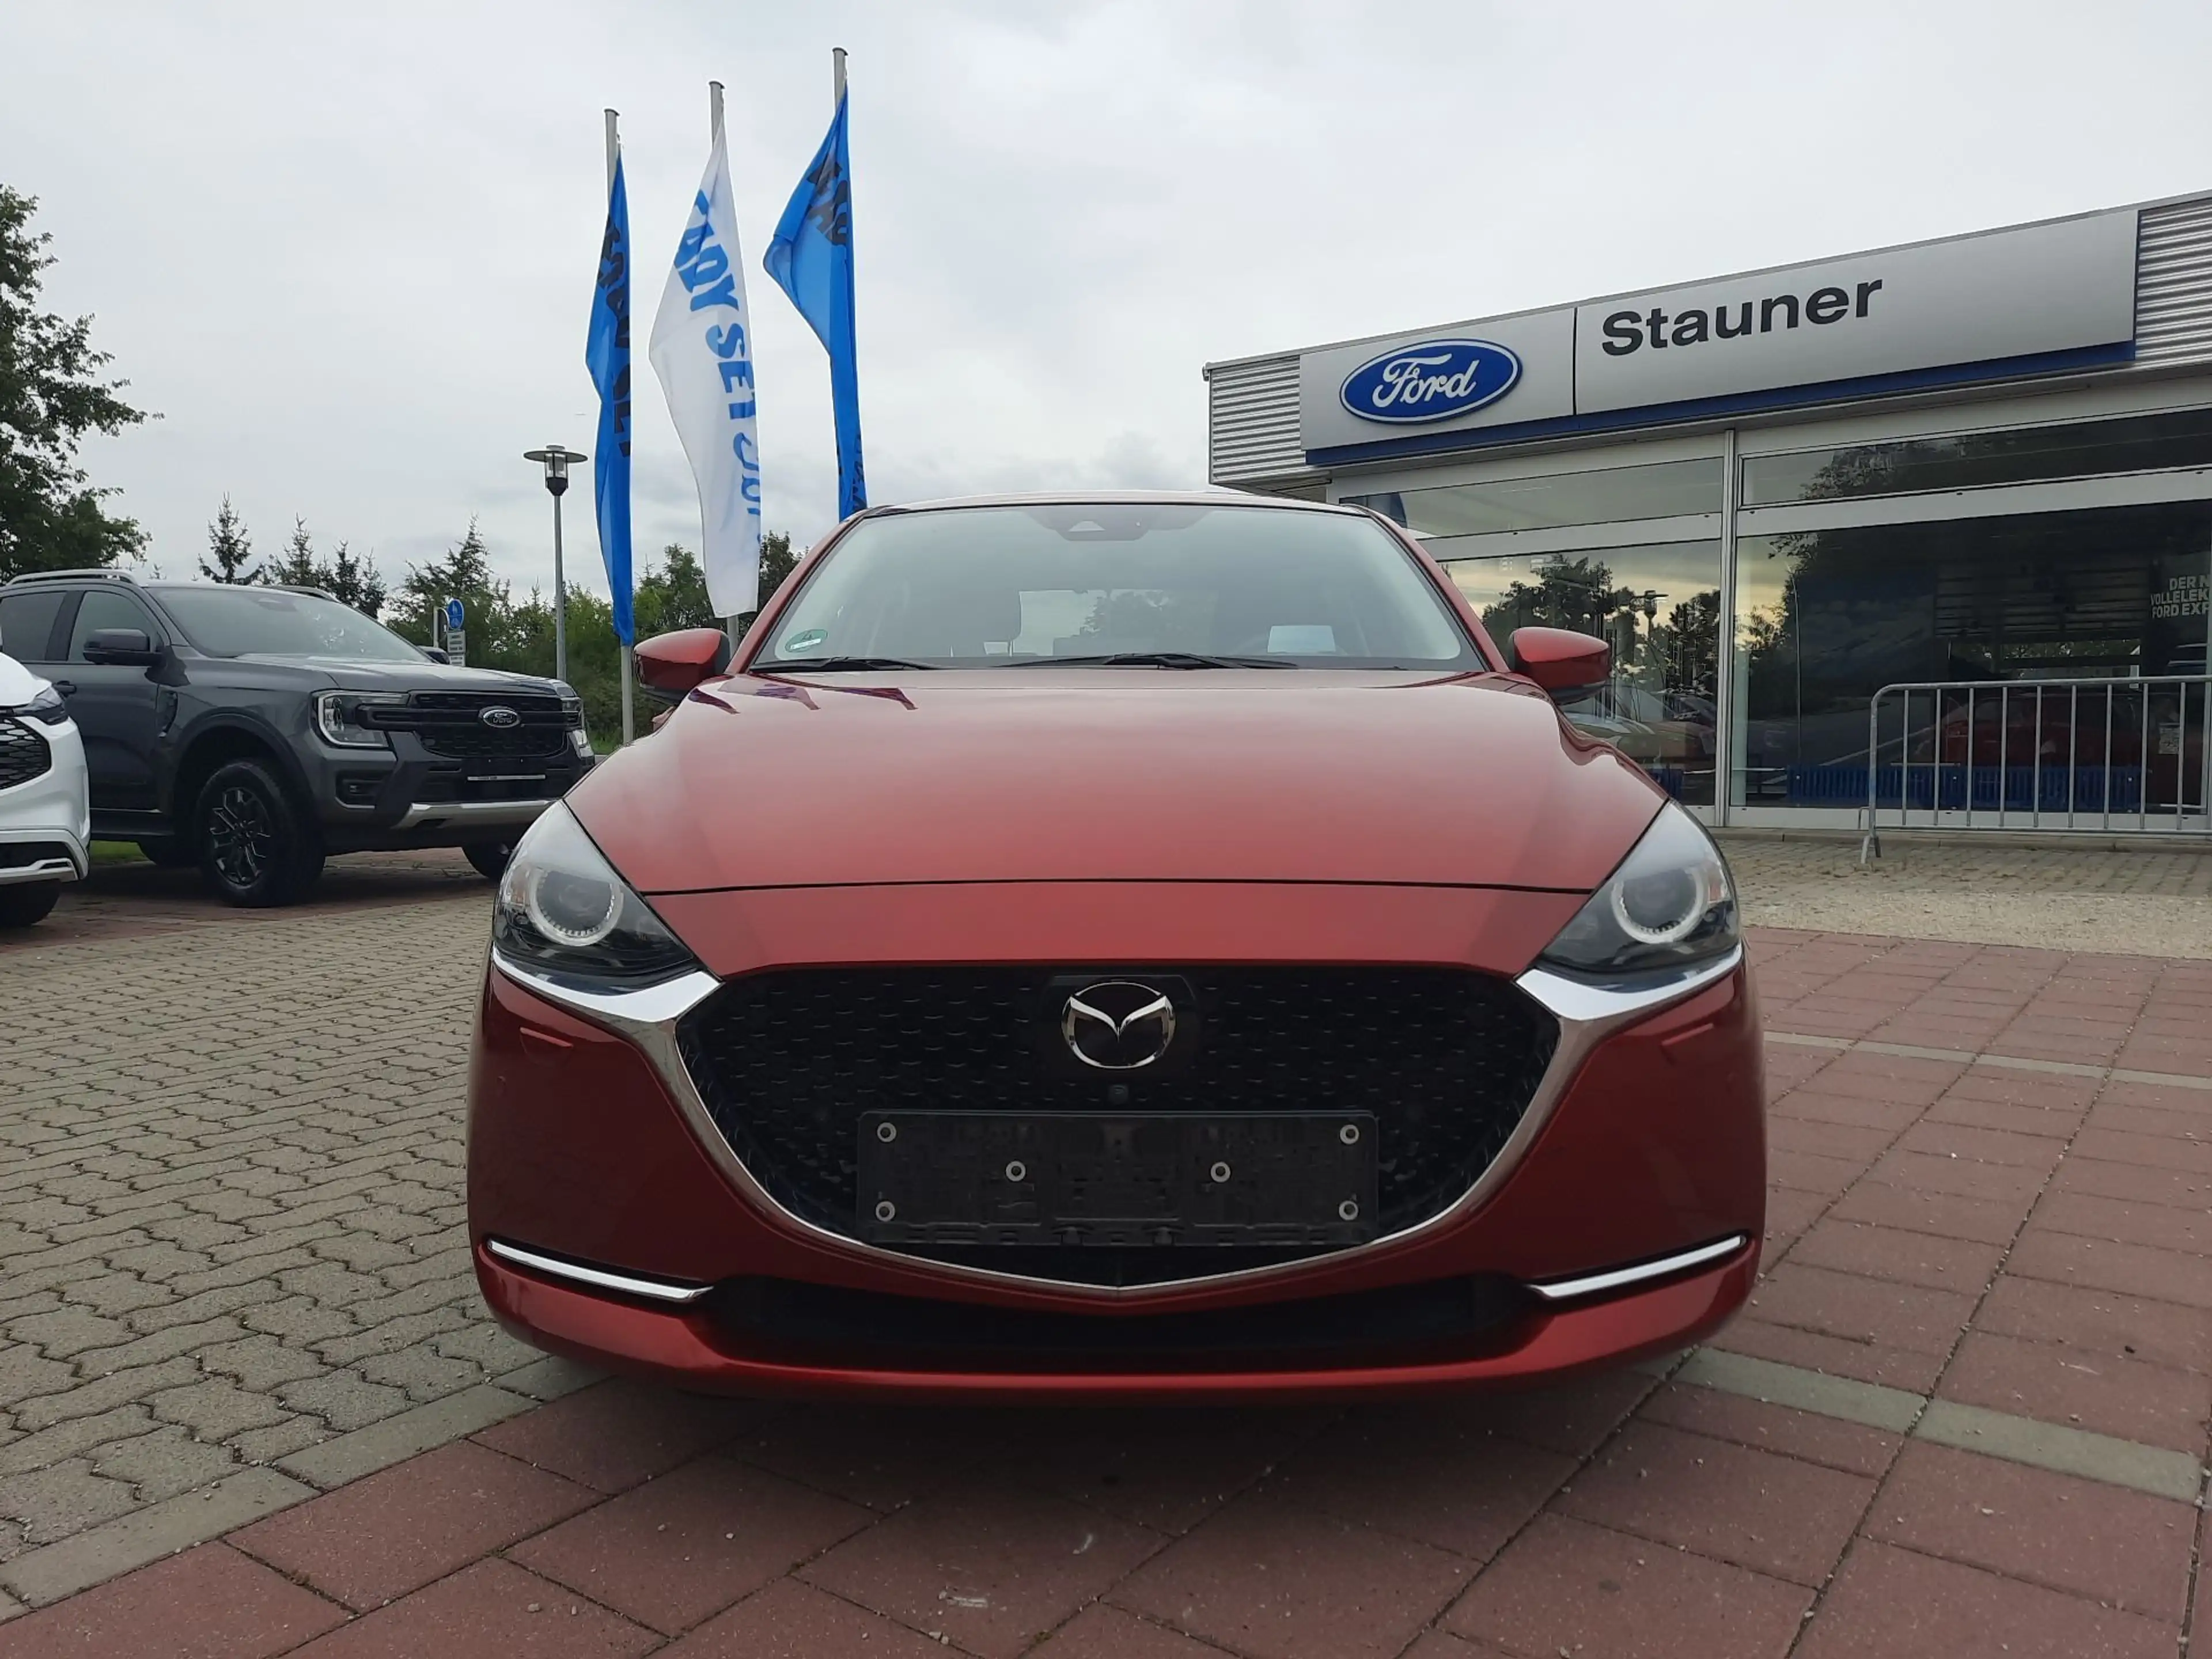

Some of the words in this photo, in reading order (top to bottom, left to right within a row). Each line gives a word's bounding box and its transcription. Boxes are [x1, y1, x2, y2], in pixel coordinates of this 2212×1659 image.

[1601, 278, 1883, 357] Stauner
[1372, 353, 1480, 408] Ford
[2169, 575, 2196, 591] DER
[2152, 604, 2180, 619] FORD
